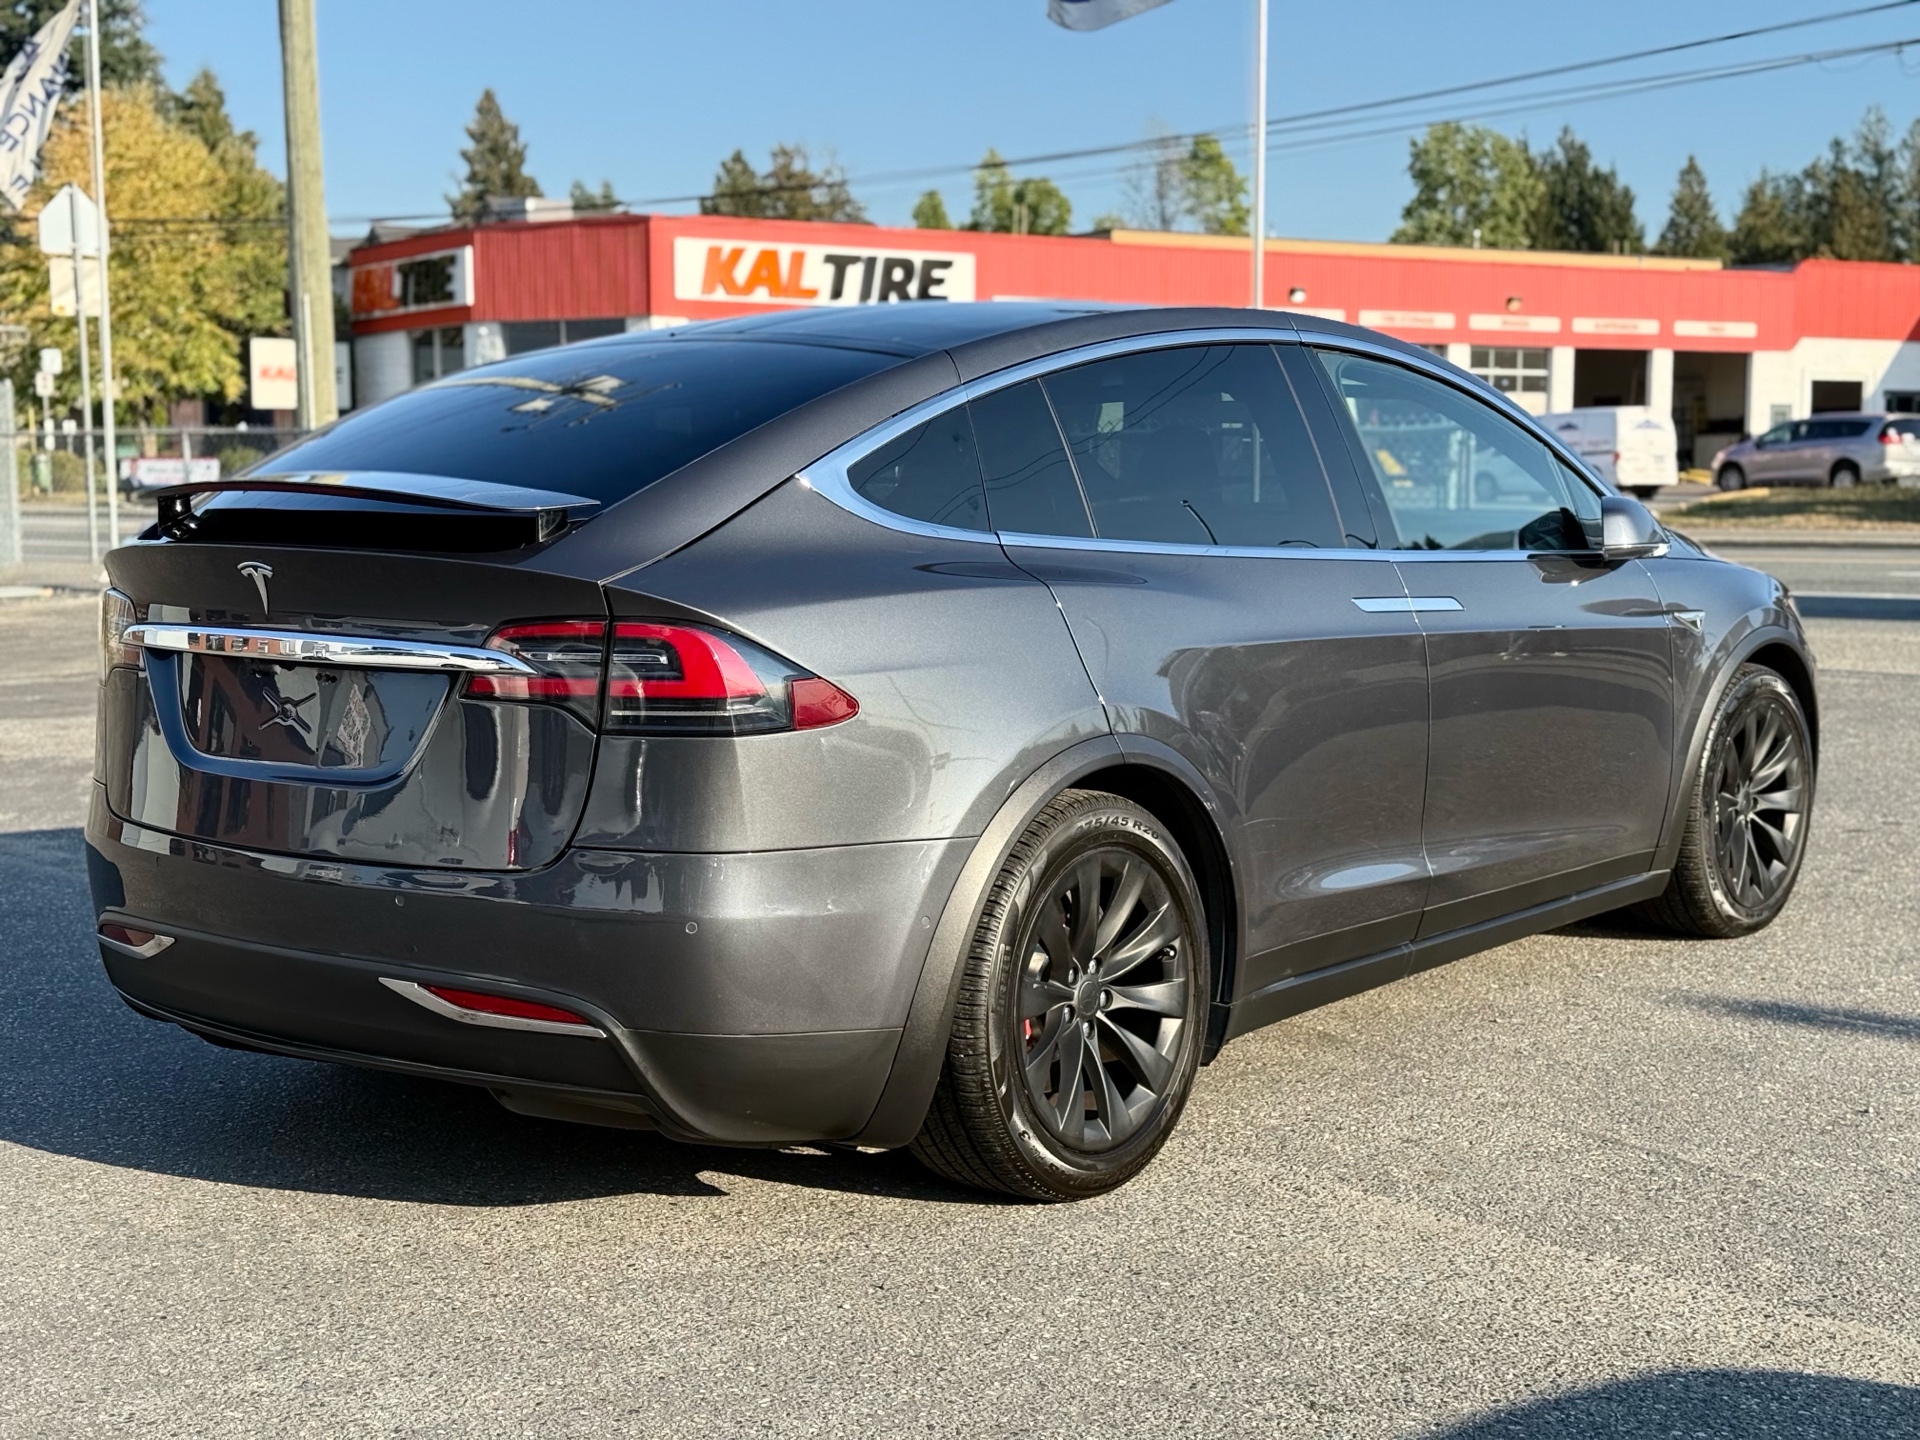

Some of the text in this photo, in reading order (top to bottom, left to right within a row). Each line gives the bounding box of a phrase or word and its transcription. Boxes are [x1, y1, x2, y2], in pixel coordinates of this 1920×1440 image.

[702, 245, 954, 304] KAL TIRE
[206, 633, 328, 658] TESLA
[1132, 819, 1161, 841] R20
